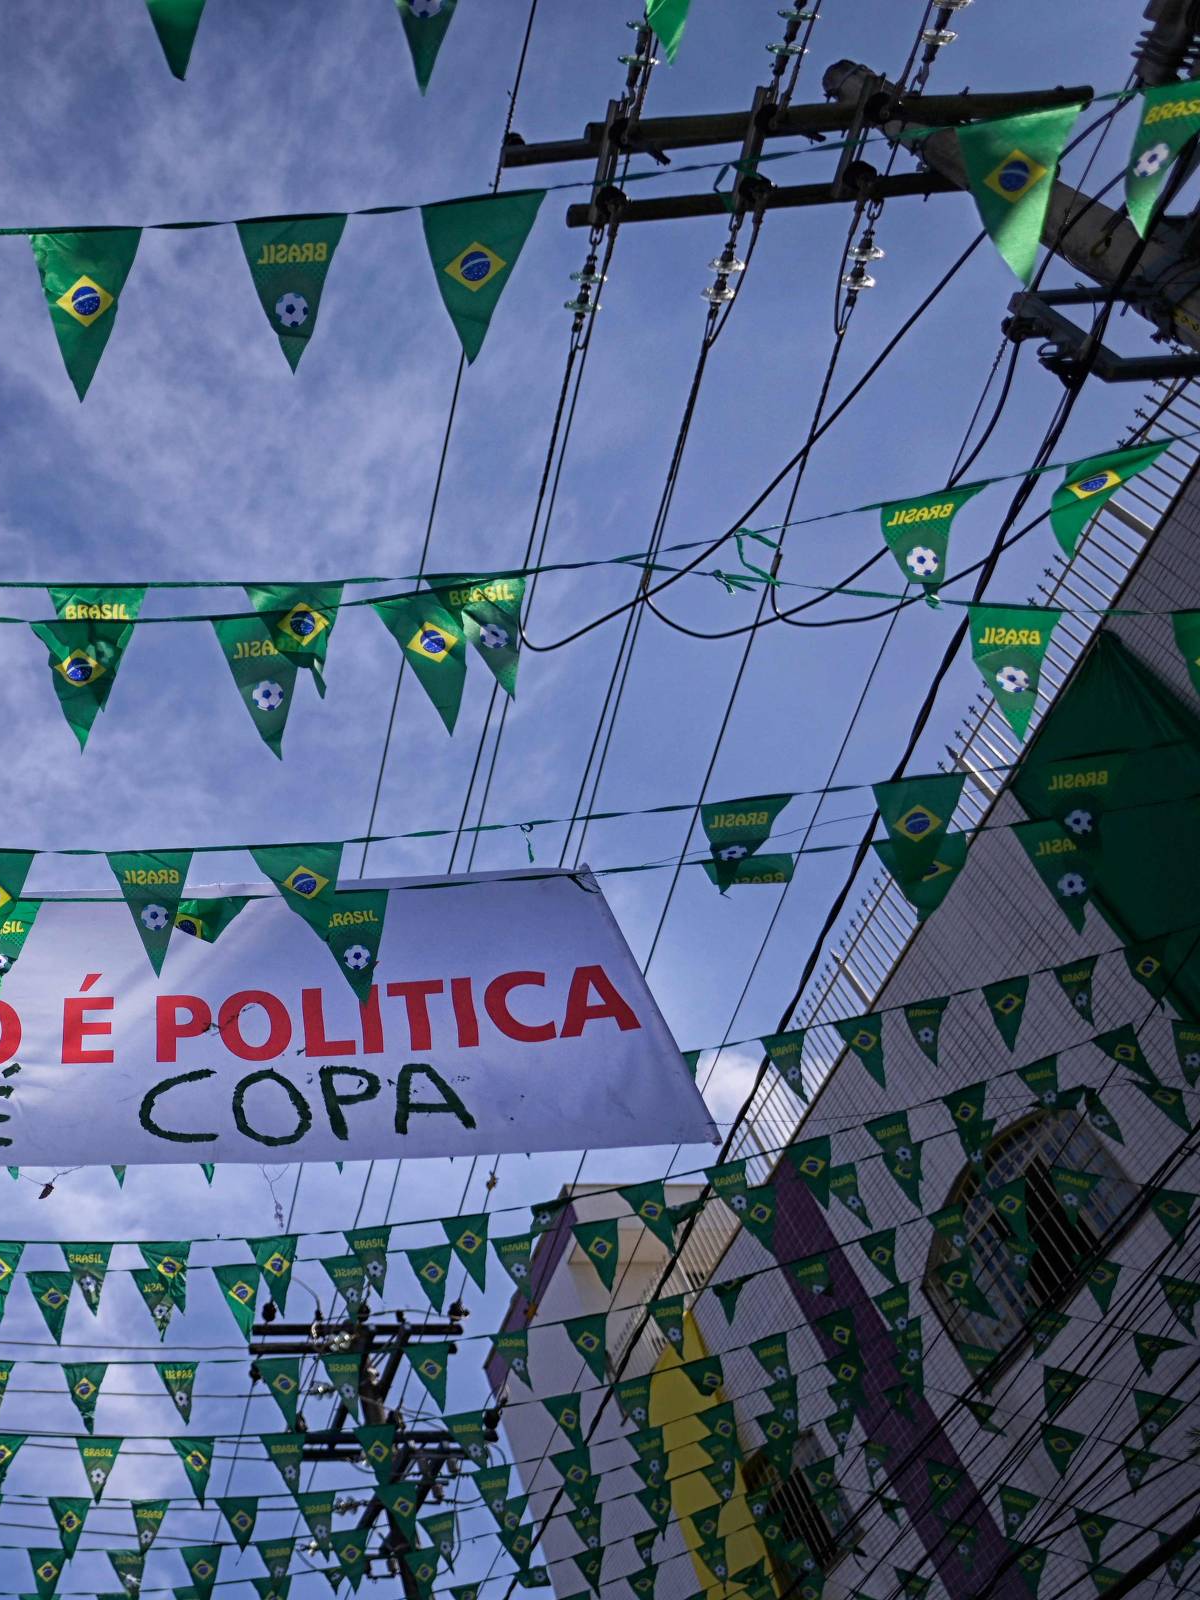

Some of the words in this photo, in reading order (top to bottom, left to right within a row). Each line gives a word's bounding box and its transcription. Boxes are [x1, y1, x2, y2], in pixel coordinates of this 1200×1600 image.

[450, 584, 514, 605] BRASIL
[66, 604, 128, 621] BRASIL
[0, 921, 24, 934] SIL
[329, 912, 378, 928] RASIL
[61, 974, 115, 1065] É
[156, 961, 640, 1062] POLÍTICA
[138, 1063, 477, 1147] COPA
[353, 1239, 385, 1249] BRASIL
